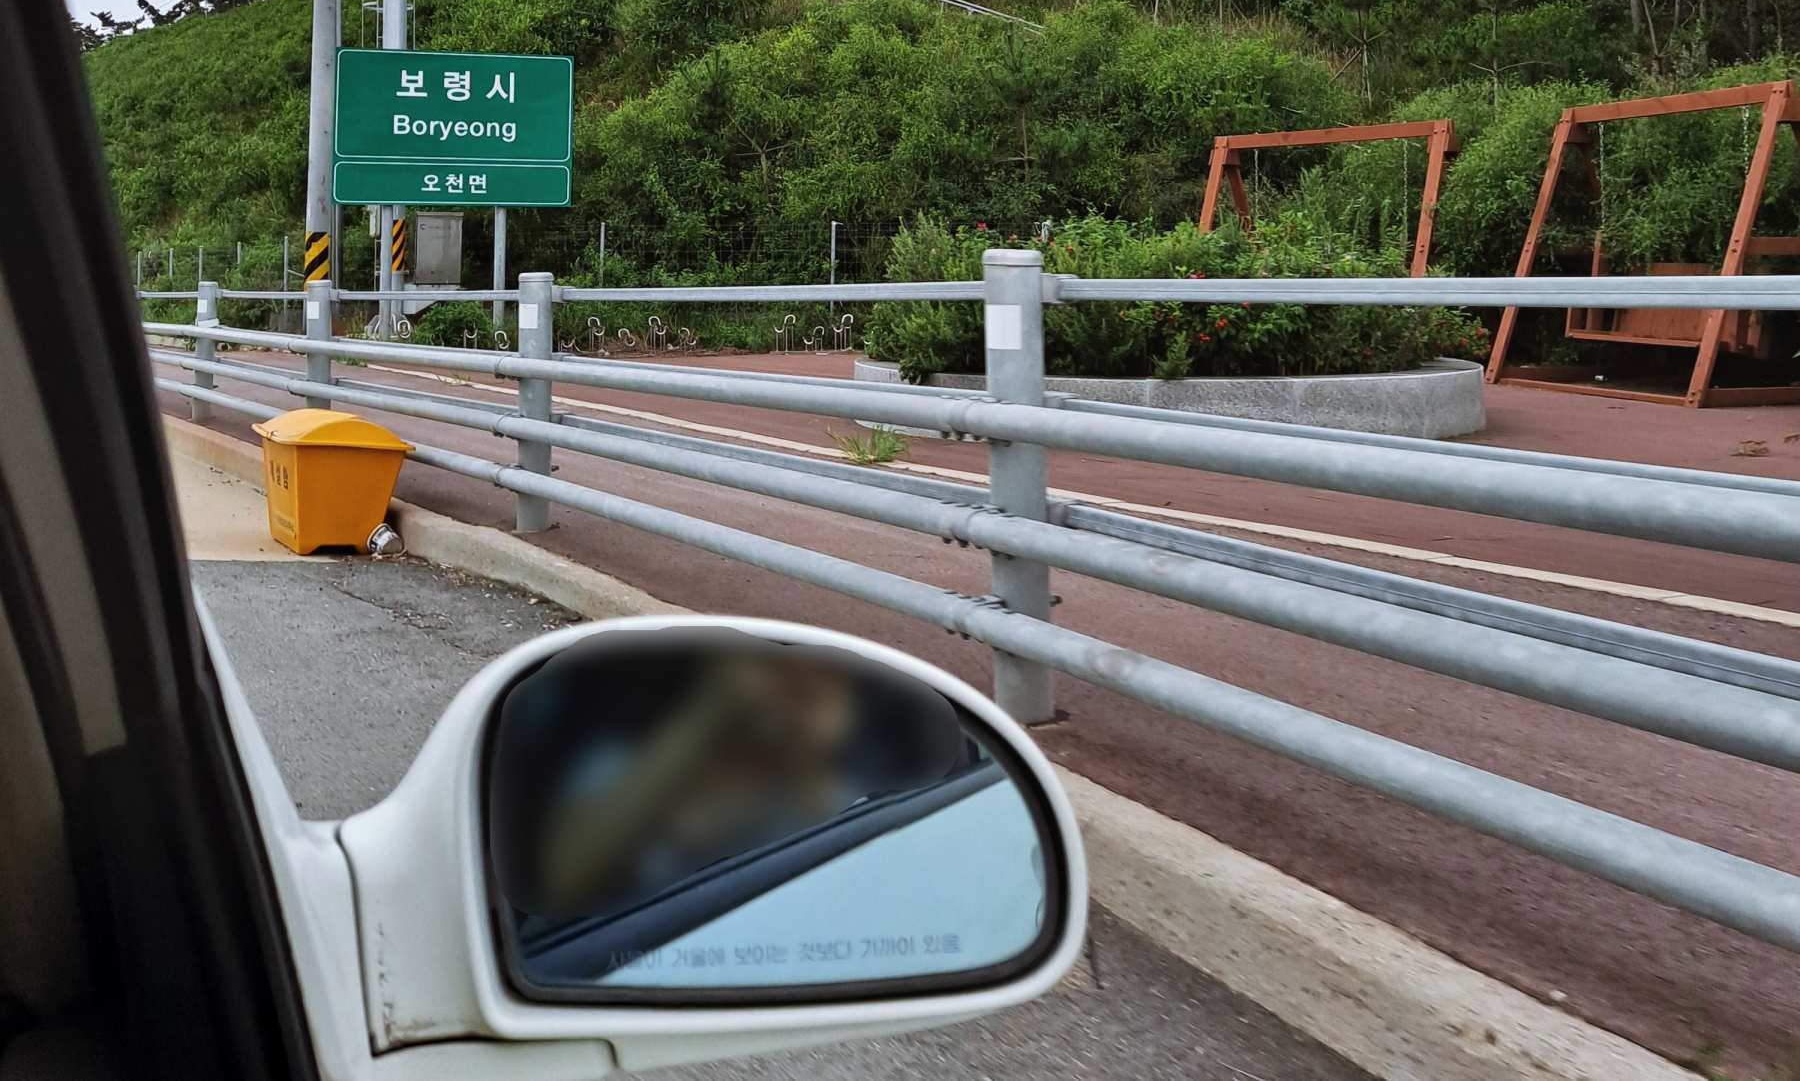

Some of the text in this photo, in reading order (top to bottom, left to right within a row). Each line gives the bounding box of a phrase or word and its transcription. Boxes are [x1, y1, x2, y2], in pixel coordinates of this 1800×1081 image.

[393, 114, 517, 142] Boryeong
[421, 173, 487, 194] 오천면
[735, 945, 789, 966] 보이는
[799, 939, 851, 962] 것보다
[861, 936, 914, 960] 가까이
